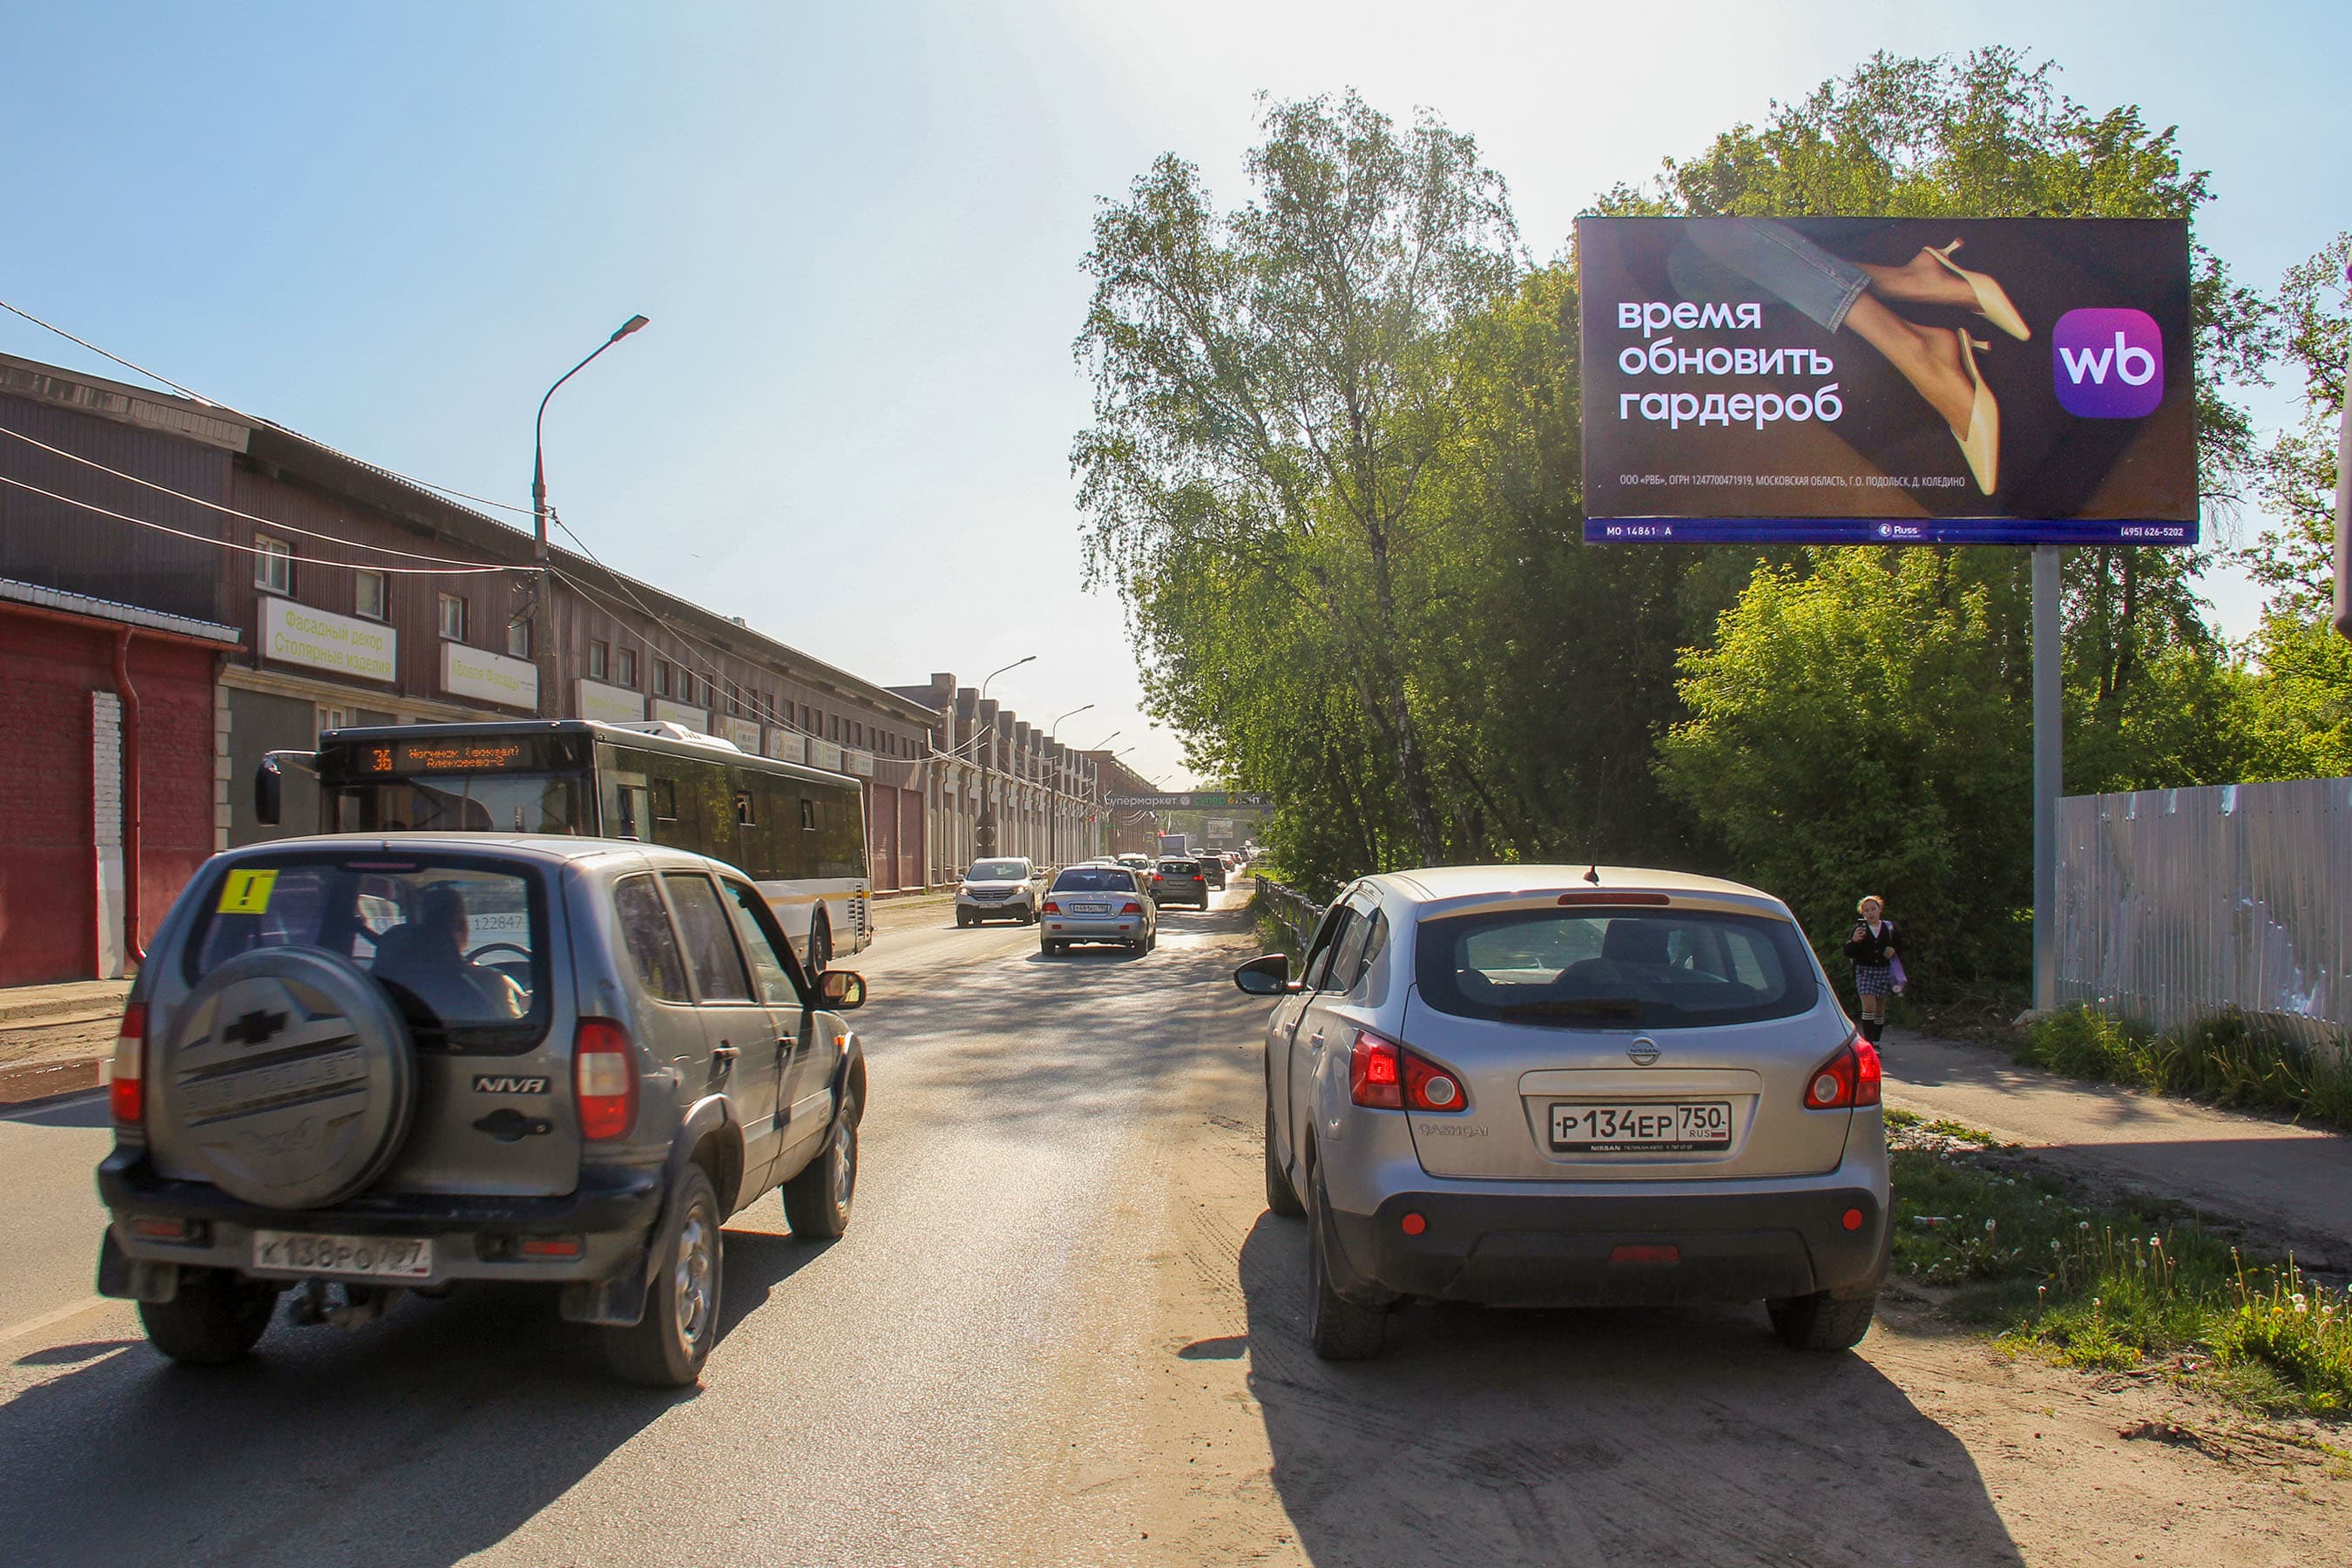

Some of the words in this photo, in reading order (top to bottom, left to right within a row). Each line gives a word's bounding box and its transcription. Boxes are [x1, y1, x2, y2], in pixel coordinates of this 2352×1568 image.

[1618, 301, 1761, 338] время
[1618, 336, 1834, 375] обновить
[2058, 331, 2156, 386] wb
[1619, 382, 1843, 430] гардероб
[1619, 474, 1639, 485] ООО
[1639, 474, 1667, 485] «РВБ»,
[1669, 475, 1689, 484] ОГРН
[1692, 475, 1754, 486] 1247700471919,
[1755, 476, 1809, 486] МОСКОВСКАЯ
[1810, 476, 1848, 487] ОБЛАСТЬ,
[1849, 476, 1864, 487] Г.О.
[1866, 476, 1910, 488] ПОДОЛЬСК,
[1911, 477, 1920, 488] Д.
[1922, 476, 1965, 488] КОЛЕДИНО
[1894, 525, 1917, 534] Russ
[2120, 527, 2142, 536] (495)
[286, 610, 348, 641] Фасадный
[351, 630, 383, 652] декор
[274, 632, 343, 665] Столярные
[346, 653, 391, 673] изделия
[475, 916, 522, 930] 122847
[475, 1078, 546, 1092] NIVA
